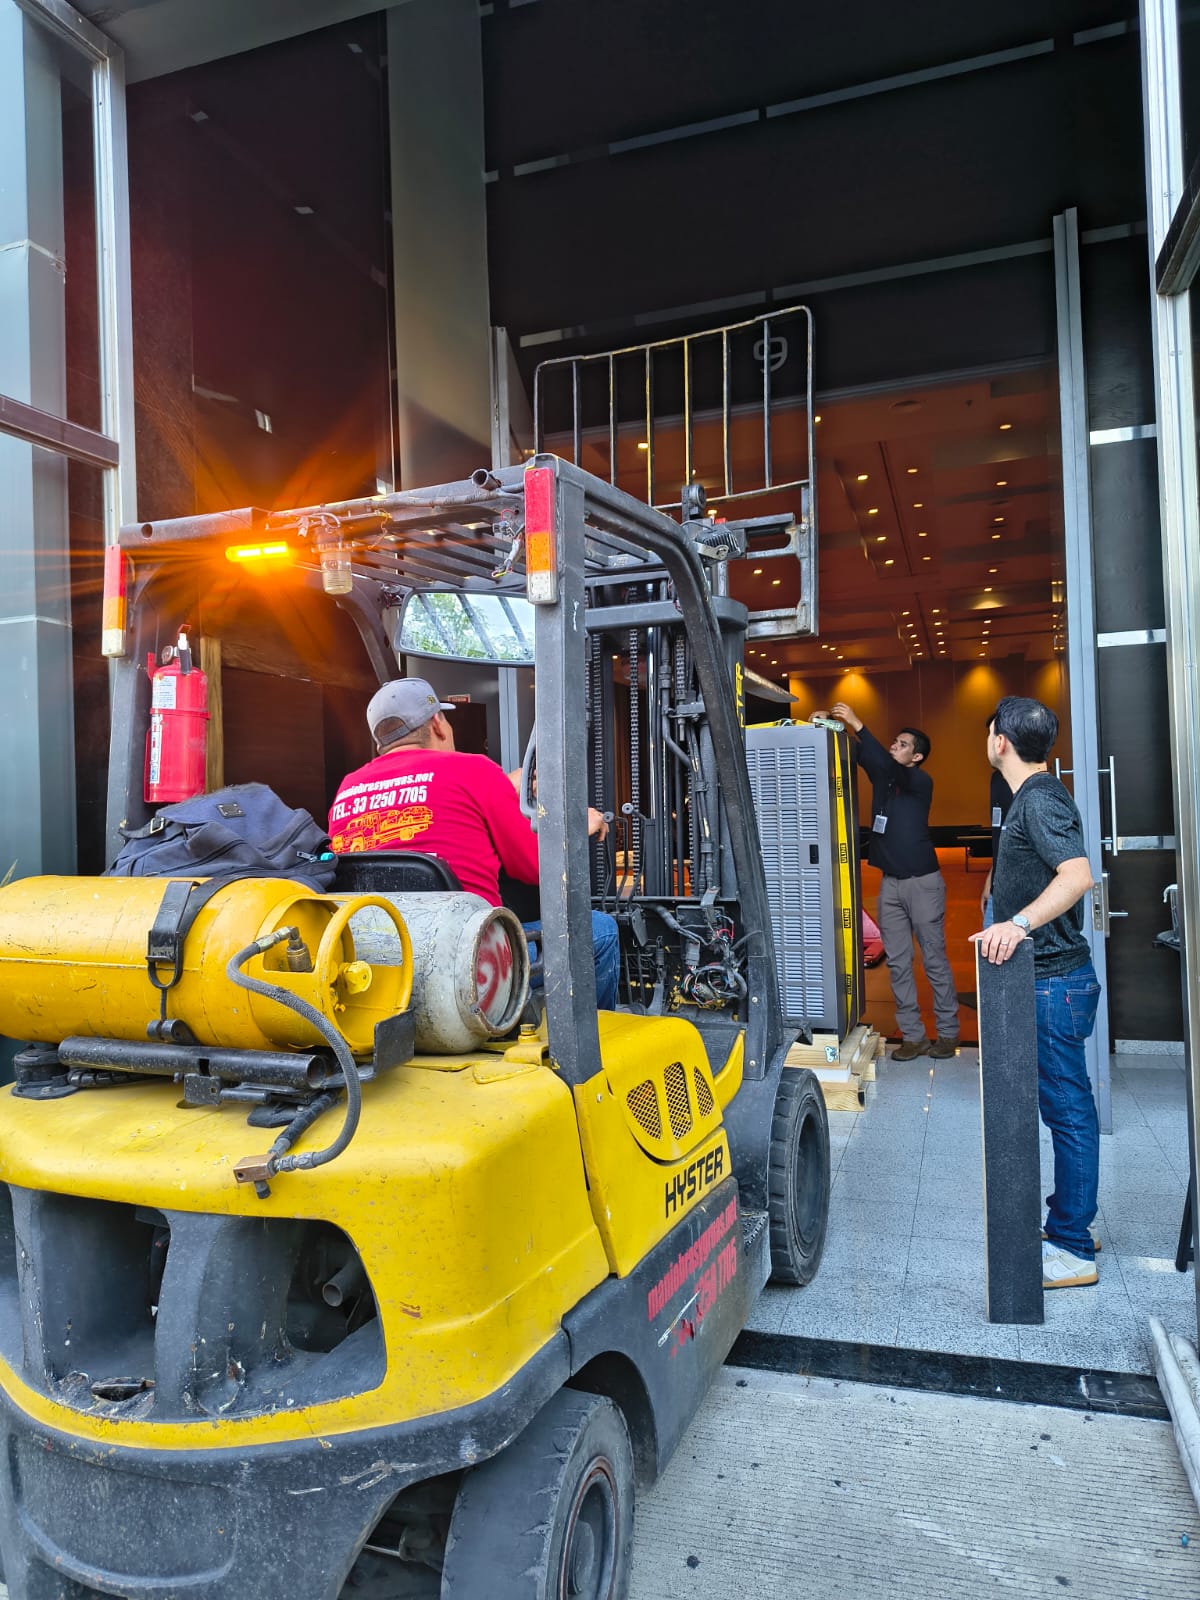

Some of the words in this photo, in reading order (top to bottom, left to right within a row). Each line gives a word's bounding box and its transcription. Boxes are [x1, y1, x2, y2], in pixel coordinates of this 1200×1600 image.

[753, 336, 788, 373] 9
[332, 801, 351, 821] TEL.:
[352, 795, 368, 814] 33
[369, 789, 397, 809] 1250
[398, 785, 428, 804] 7705
[840, 843, 848, 864] ULINE
[843, 908, 851, 929] ULINE
[665, 1144, 723, 1219] HYSTER
